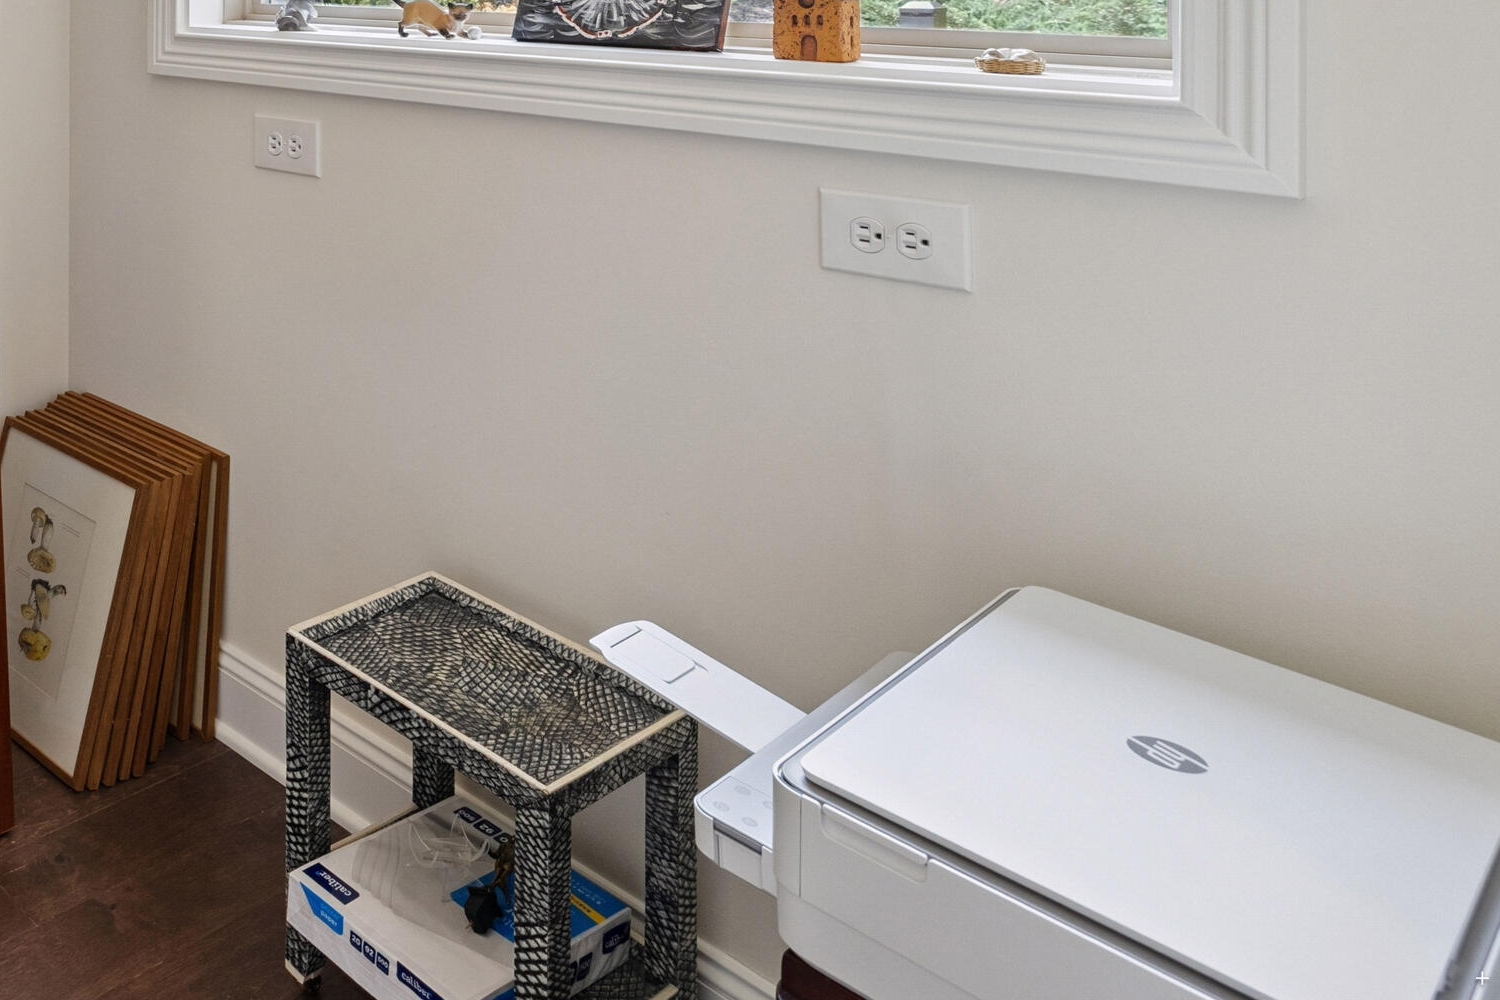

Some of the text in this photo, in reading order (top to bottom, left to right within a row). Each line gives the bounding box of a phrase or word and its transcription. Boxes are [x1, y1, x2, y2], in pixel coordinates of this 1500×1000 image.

[320, 871, 352, 897] caliber
[351, 934, 361, 946] 20
[401, 971, 431, 1000] caliber
